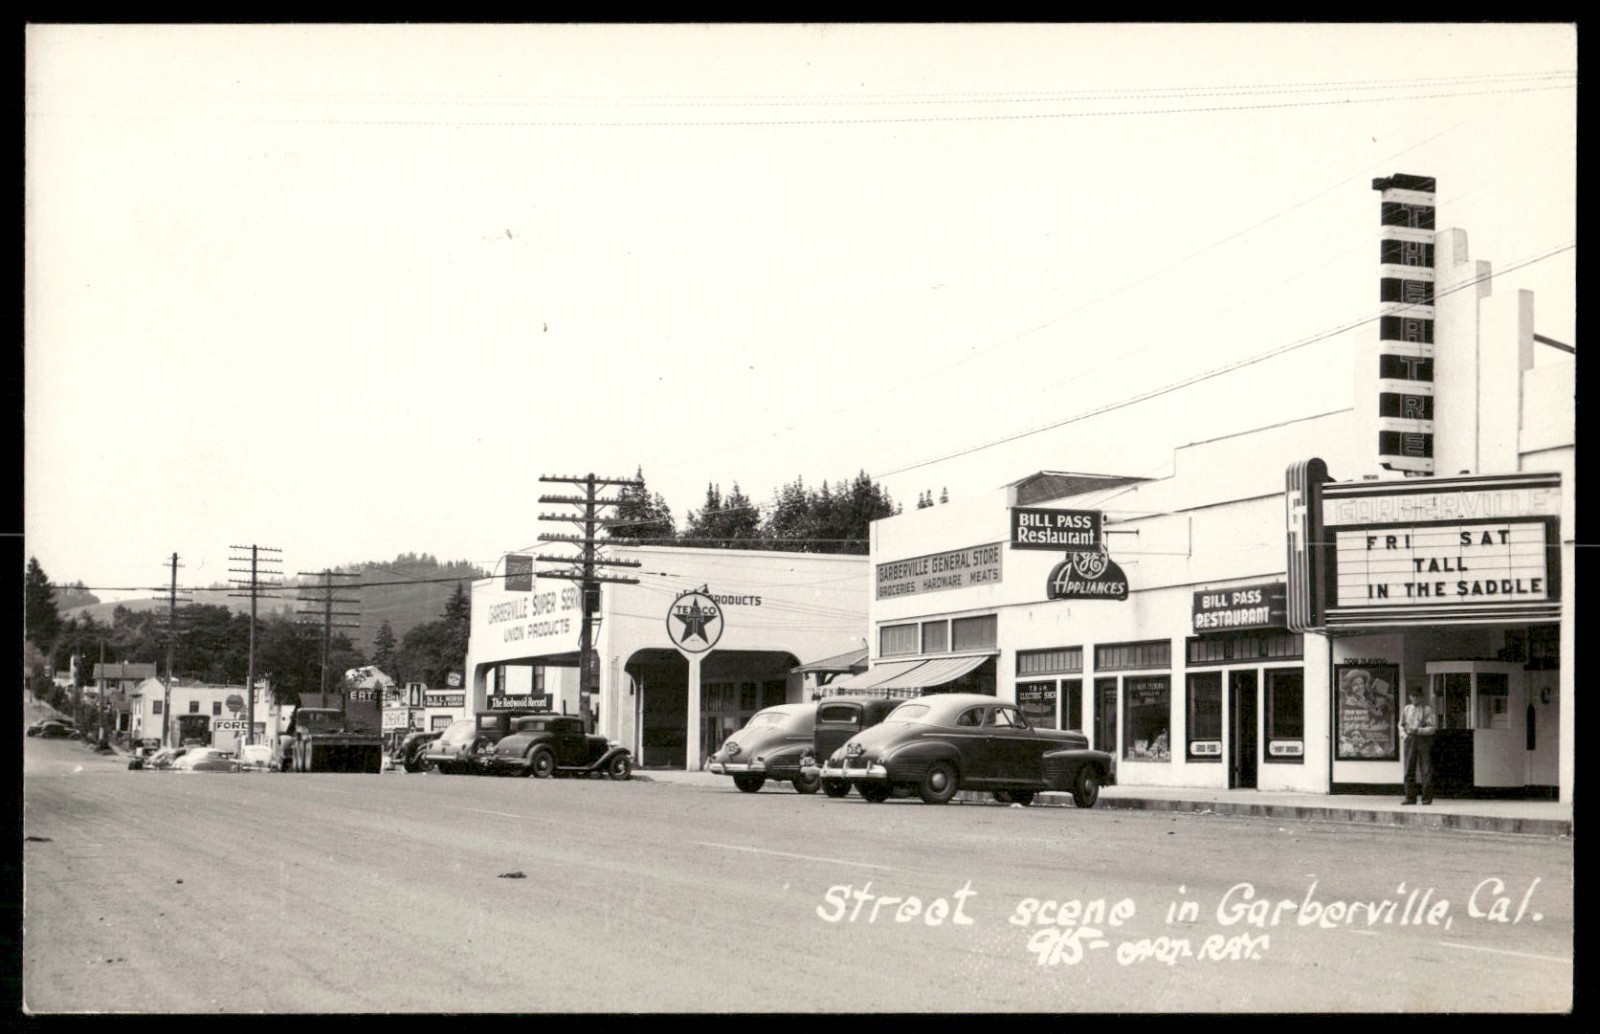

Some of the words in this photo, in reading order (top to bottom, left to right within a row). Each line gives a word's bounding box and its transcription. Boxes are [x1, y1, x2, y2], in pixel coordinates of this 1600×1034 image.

[1401, 203, 1425, 456] THEATRE
[1336, 489, 1551, 525] GARBERVILLE
[1019, 513, 1053, 527] BILL
[1057, 515, 1092, 529] PASS
[1017, 527, 1095, 545] Restaurant
[1366, 535, 1411, 550] FRI
[1460, 529, 1510, 547] SAT
[879, 559, 929, 583] GARBERVILLE
[932, 551, 971, 574] GENERAL
[973, 546, 999, 566] STORE
[1413, 556, 1468, 573] TALL
[879, 581, 916, 597] GROCERIES
[923, 574, 962, 591] HARDWARE
[970, 568, 999, 583] MEATS
[1368, 583, 1389, 598] IN
[1404, 581, 1447, 598] THE
[1457, 577, 1542, 597] SADDLE
[488, 597, 529, 625] GARBERVILLE
[532, 591, 557, 617] SUPER
[1202, 593, 1229, 609] BILL
[1232, 589, 1263, 606] PASS
[675, 604, 717, 616] TEXACO
[1195, 606, 1271, 629] RESTAURANT
[503, 622, 525, 643] UNION
[527, 617, 571, 639] PRODUCTS
[350, 691, 373, 700] EAT
[491, 696, 502, 710] The
[216, 721, 249, 730] FORD
